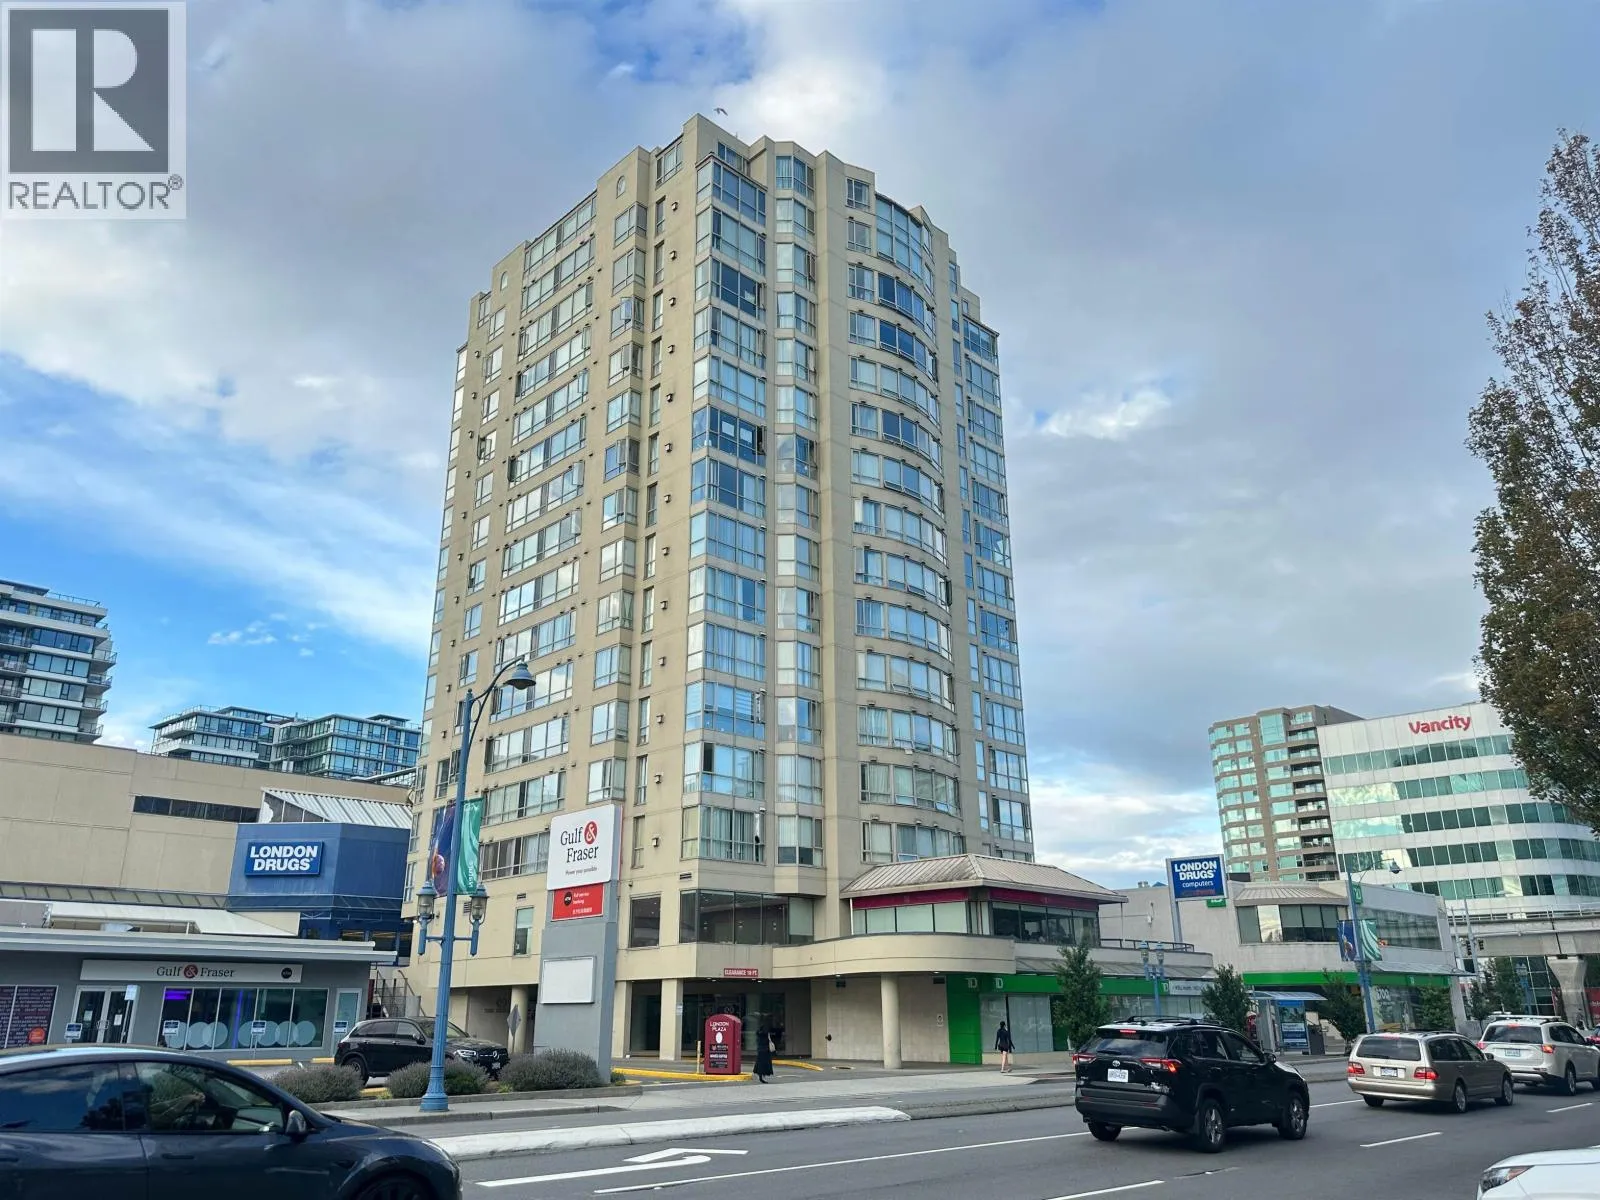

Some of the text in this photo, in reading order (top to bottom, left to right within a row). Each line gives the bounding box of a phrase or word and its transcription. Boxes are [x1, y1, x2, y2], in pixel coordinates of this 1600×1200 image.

[1408, 715, 1471, 734] Vancity
[560, 827, 583, 846] Gulf
[250, 845, 318, 858] LONDON
[566, 846, 599, 863] Fraser
[1174, 861, 1217, 872] LONDON
[156, 966, 182, 977] Gulf
[200, 967, 237, 977] Fraser
